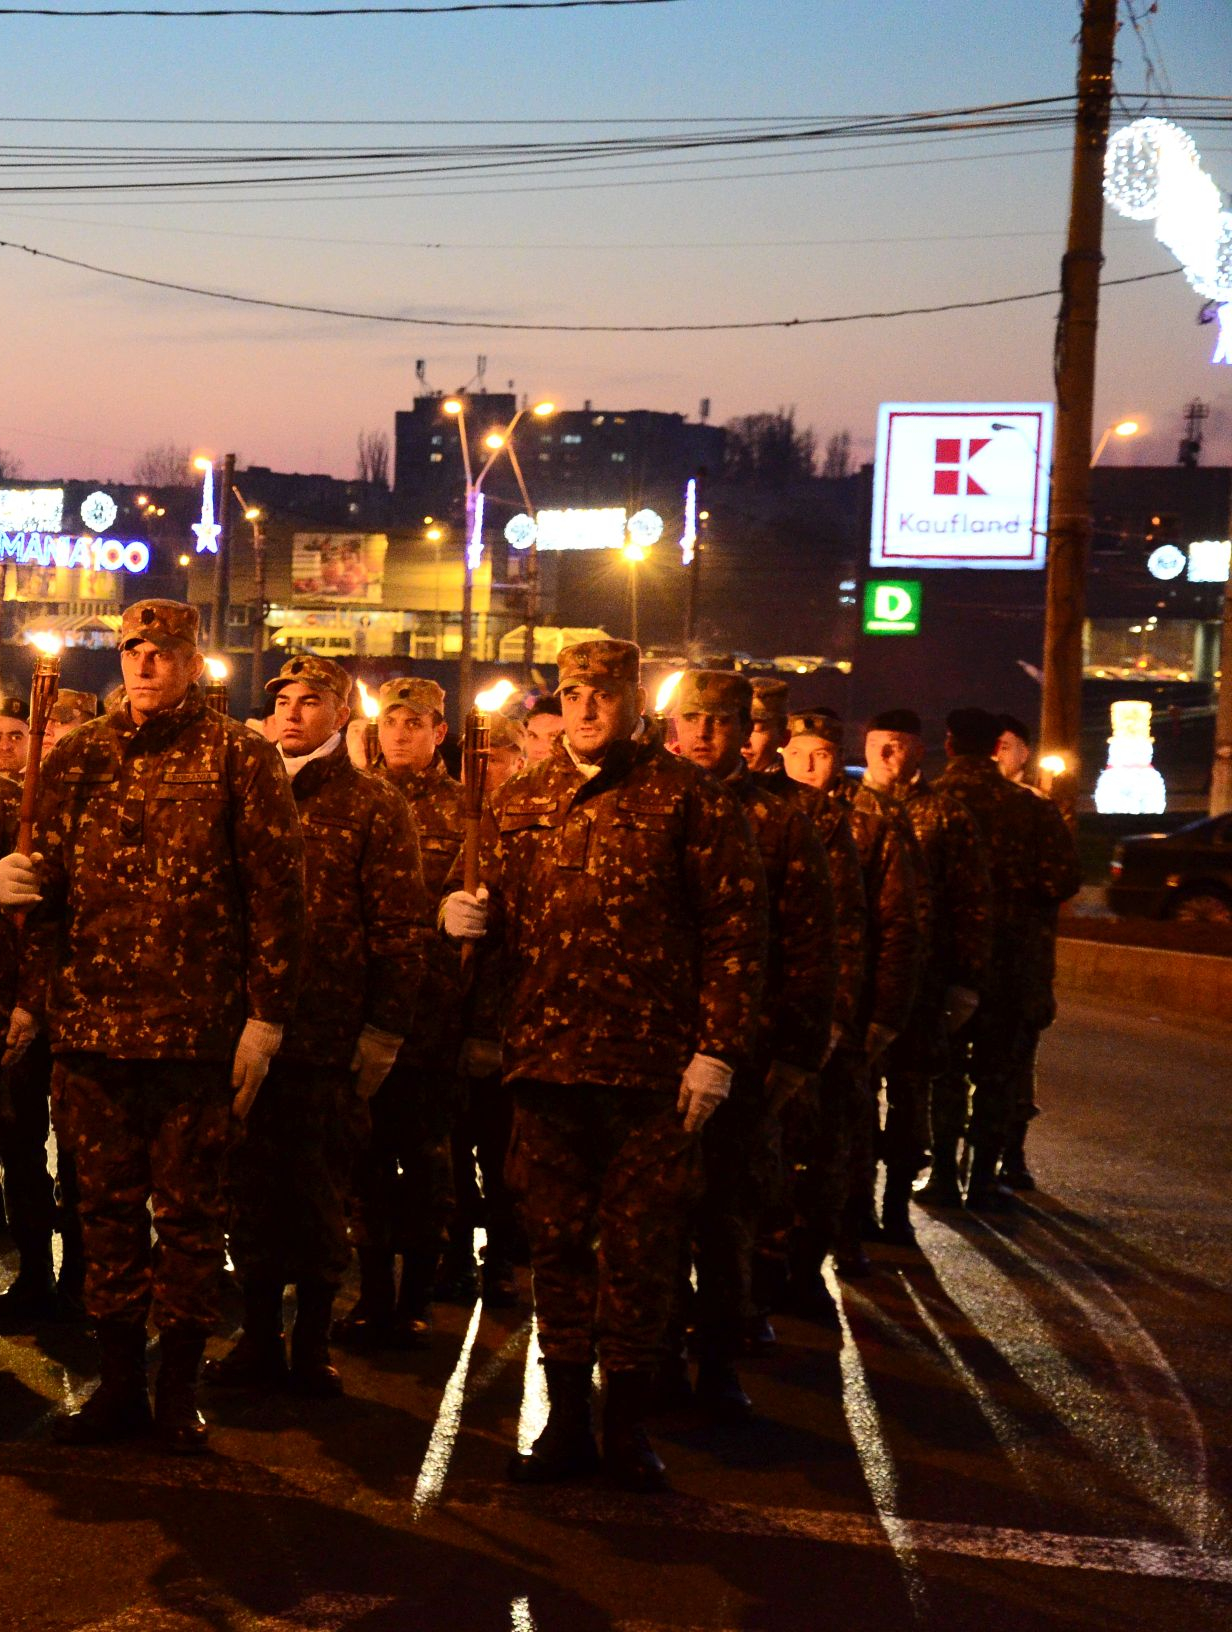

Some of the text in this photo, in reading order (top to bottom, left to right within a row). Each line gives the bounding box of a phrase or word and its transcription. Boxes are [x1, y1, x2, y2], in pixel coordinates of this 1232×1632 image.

[933, 438, 993, 495] K
[899, 513, 1020, 534] Kaufland
[874, 585, 912, 620] D
